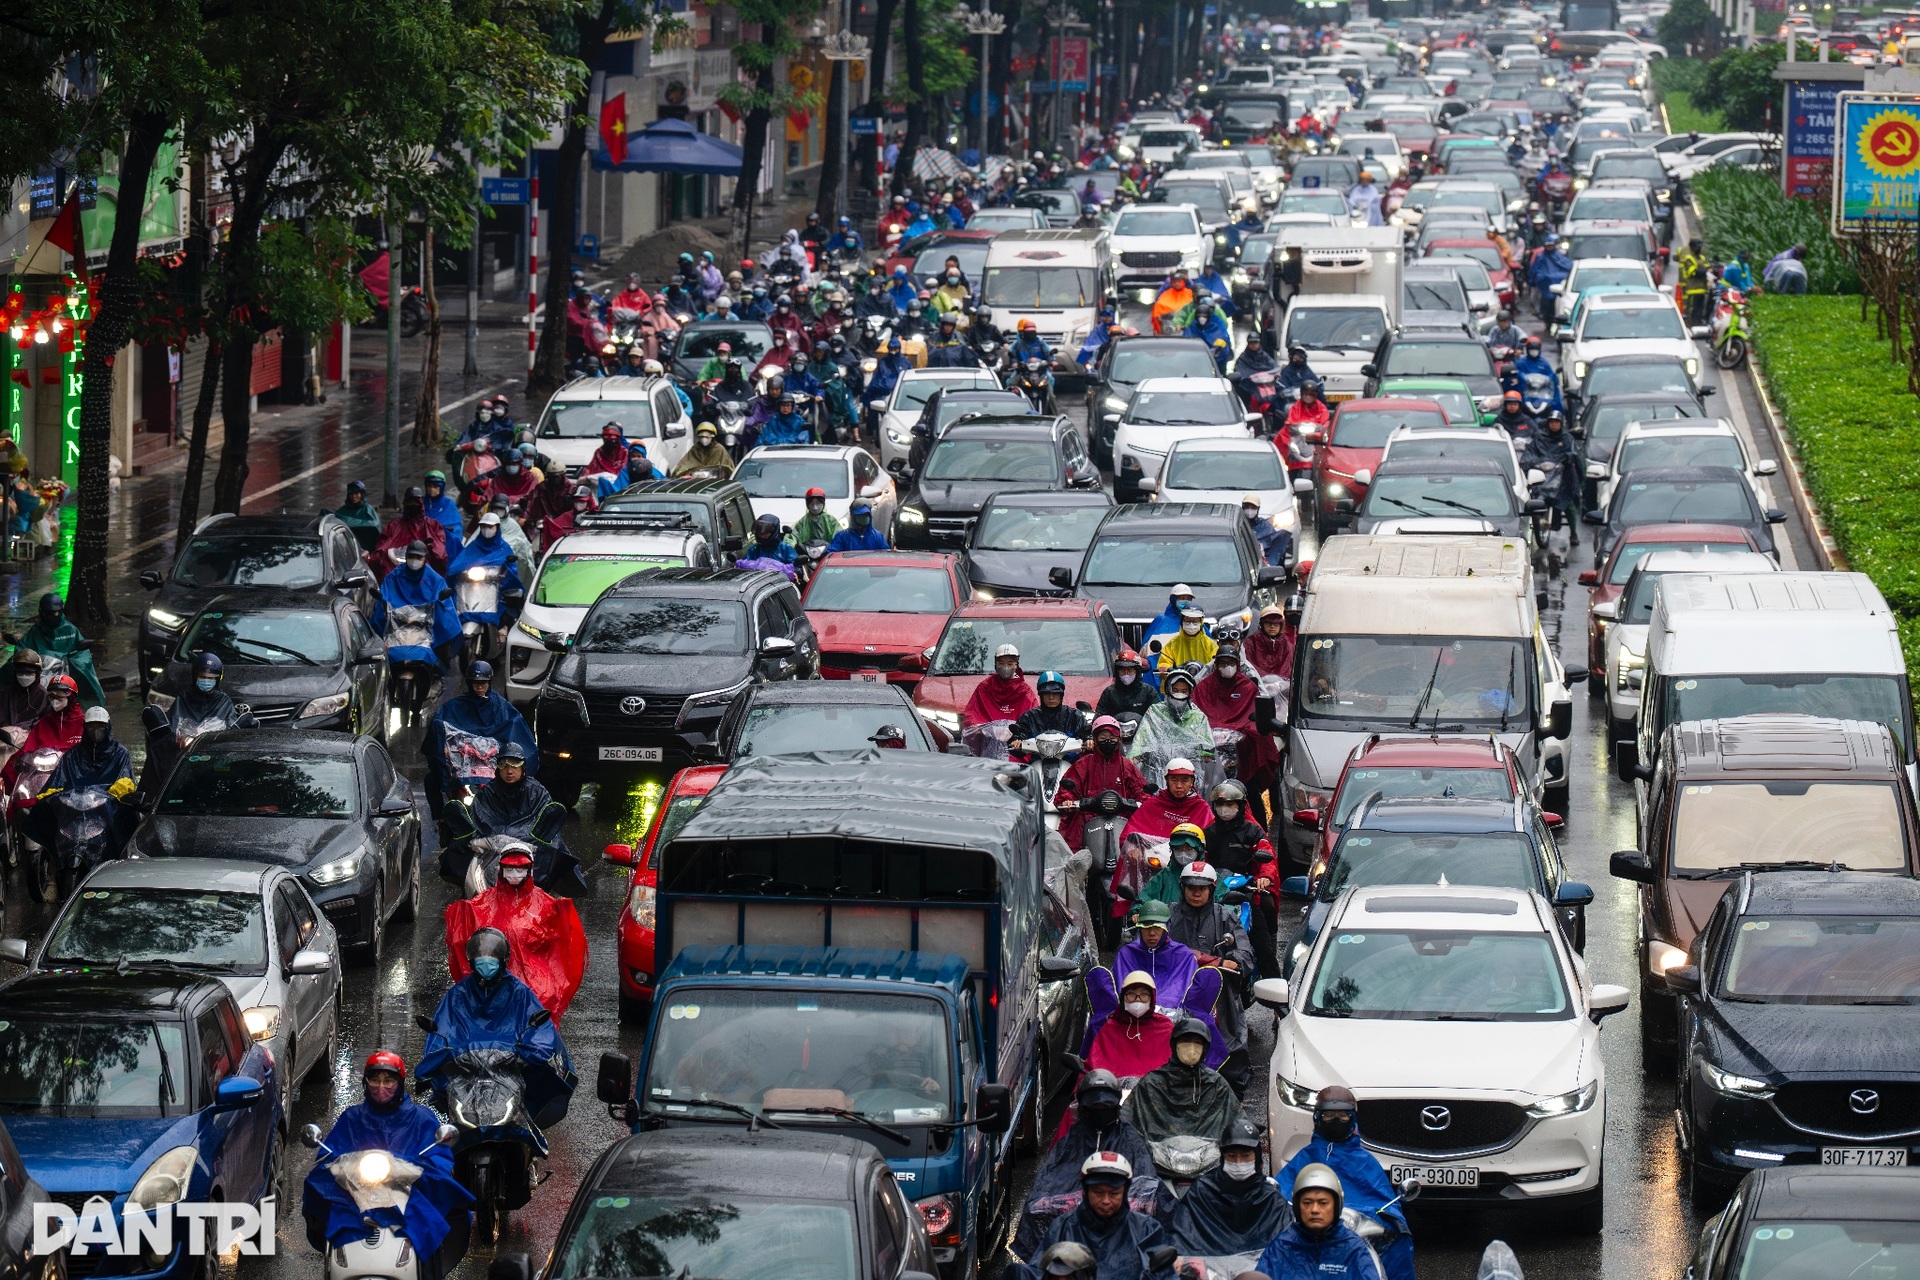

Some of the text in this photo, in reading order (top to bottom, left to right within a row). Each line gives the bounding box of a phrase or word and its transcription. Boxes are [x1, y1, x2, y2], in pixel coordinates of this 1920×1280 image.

[575, 555, 667, 563] PERFORMANCE
[1824, 1149, 1905, 1167] 30F-717.37
[1393, 1167, 1476, 1185] 30F-930.09
